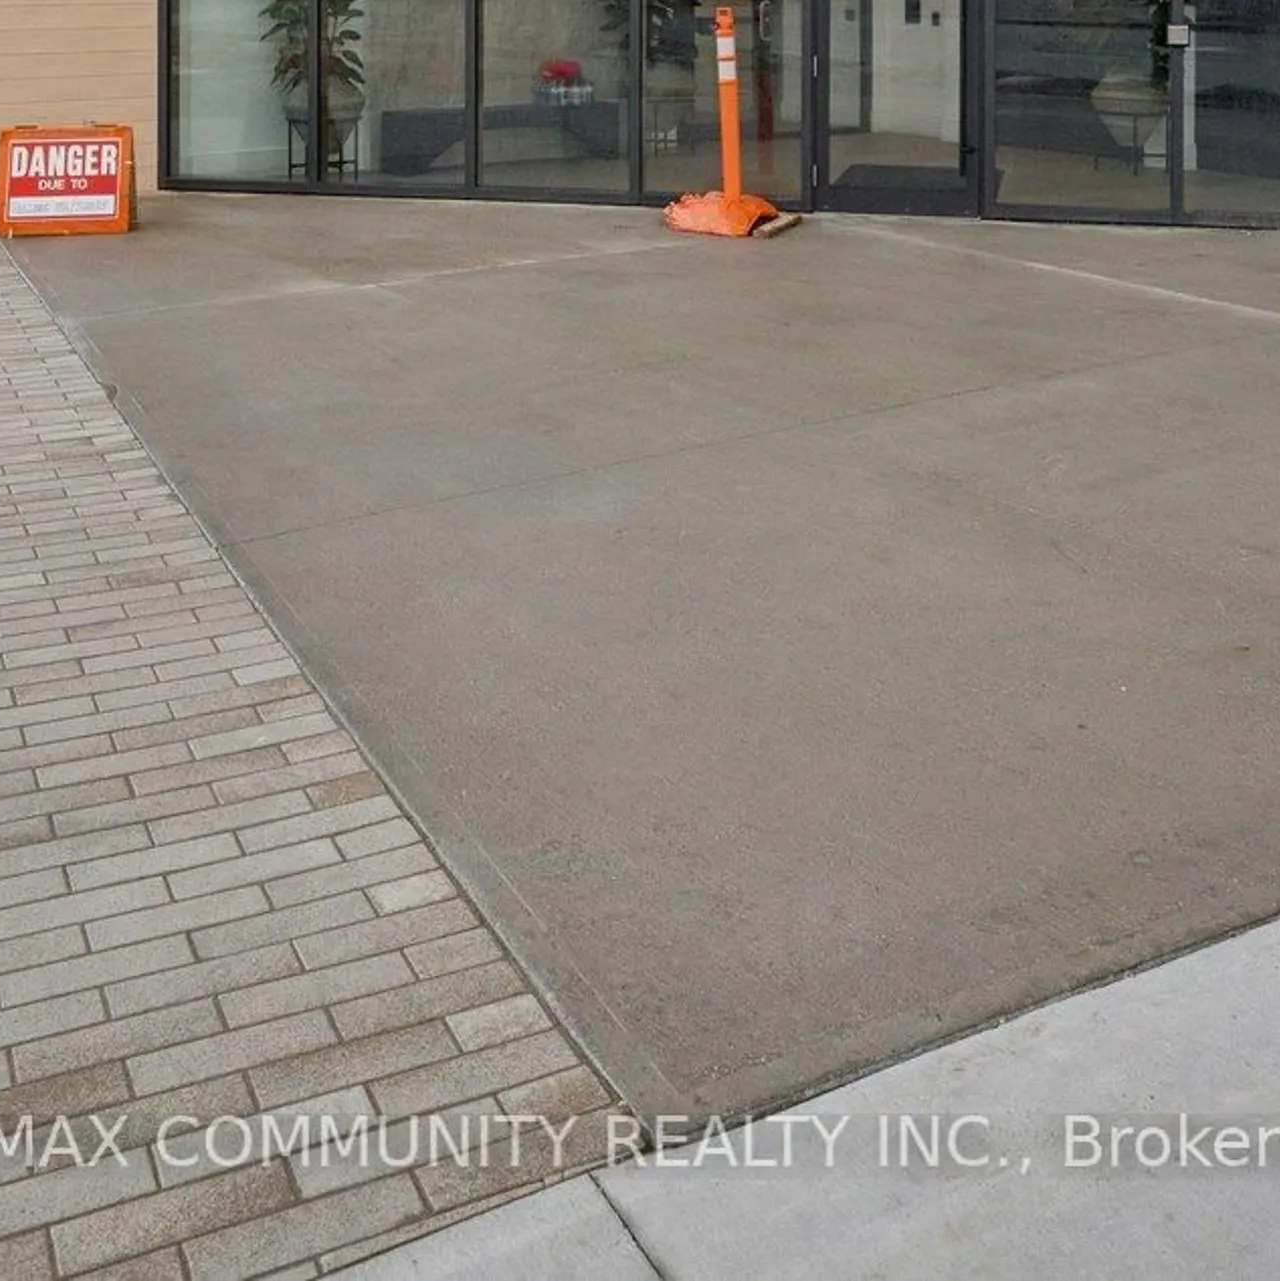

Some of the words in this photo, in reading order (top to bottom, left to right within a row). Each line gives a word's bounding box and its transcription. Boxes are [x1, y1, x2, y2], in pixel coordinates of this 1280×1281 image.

[10, 144, 119, 178] DANGER
[37, 179, 66, 192] DUE
[70, 178, 89, 191] TO
